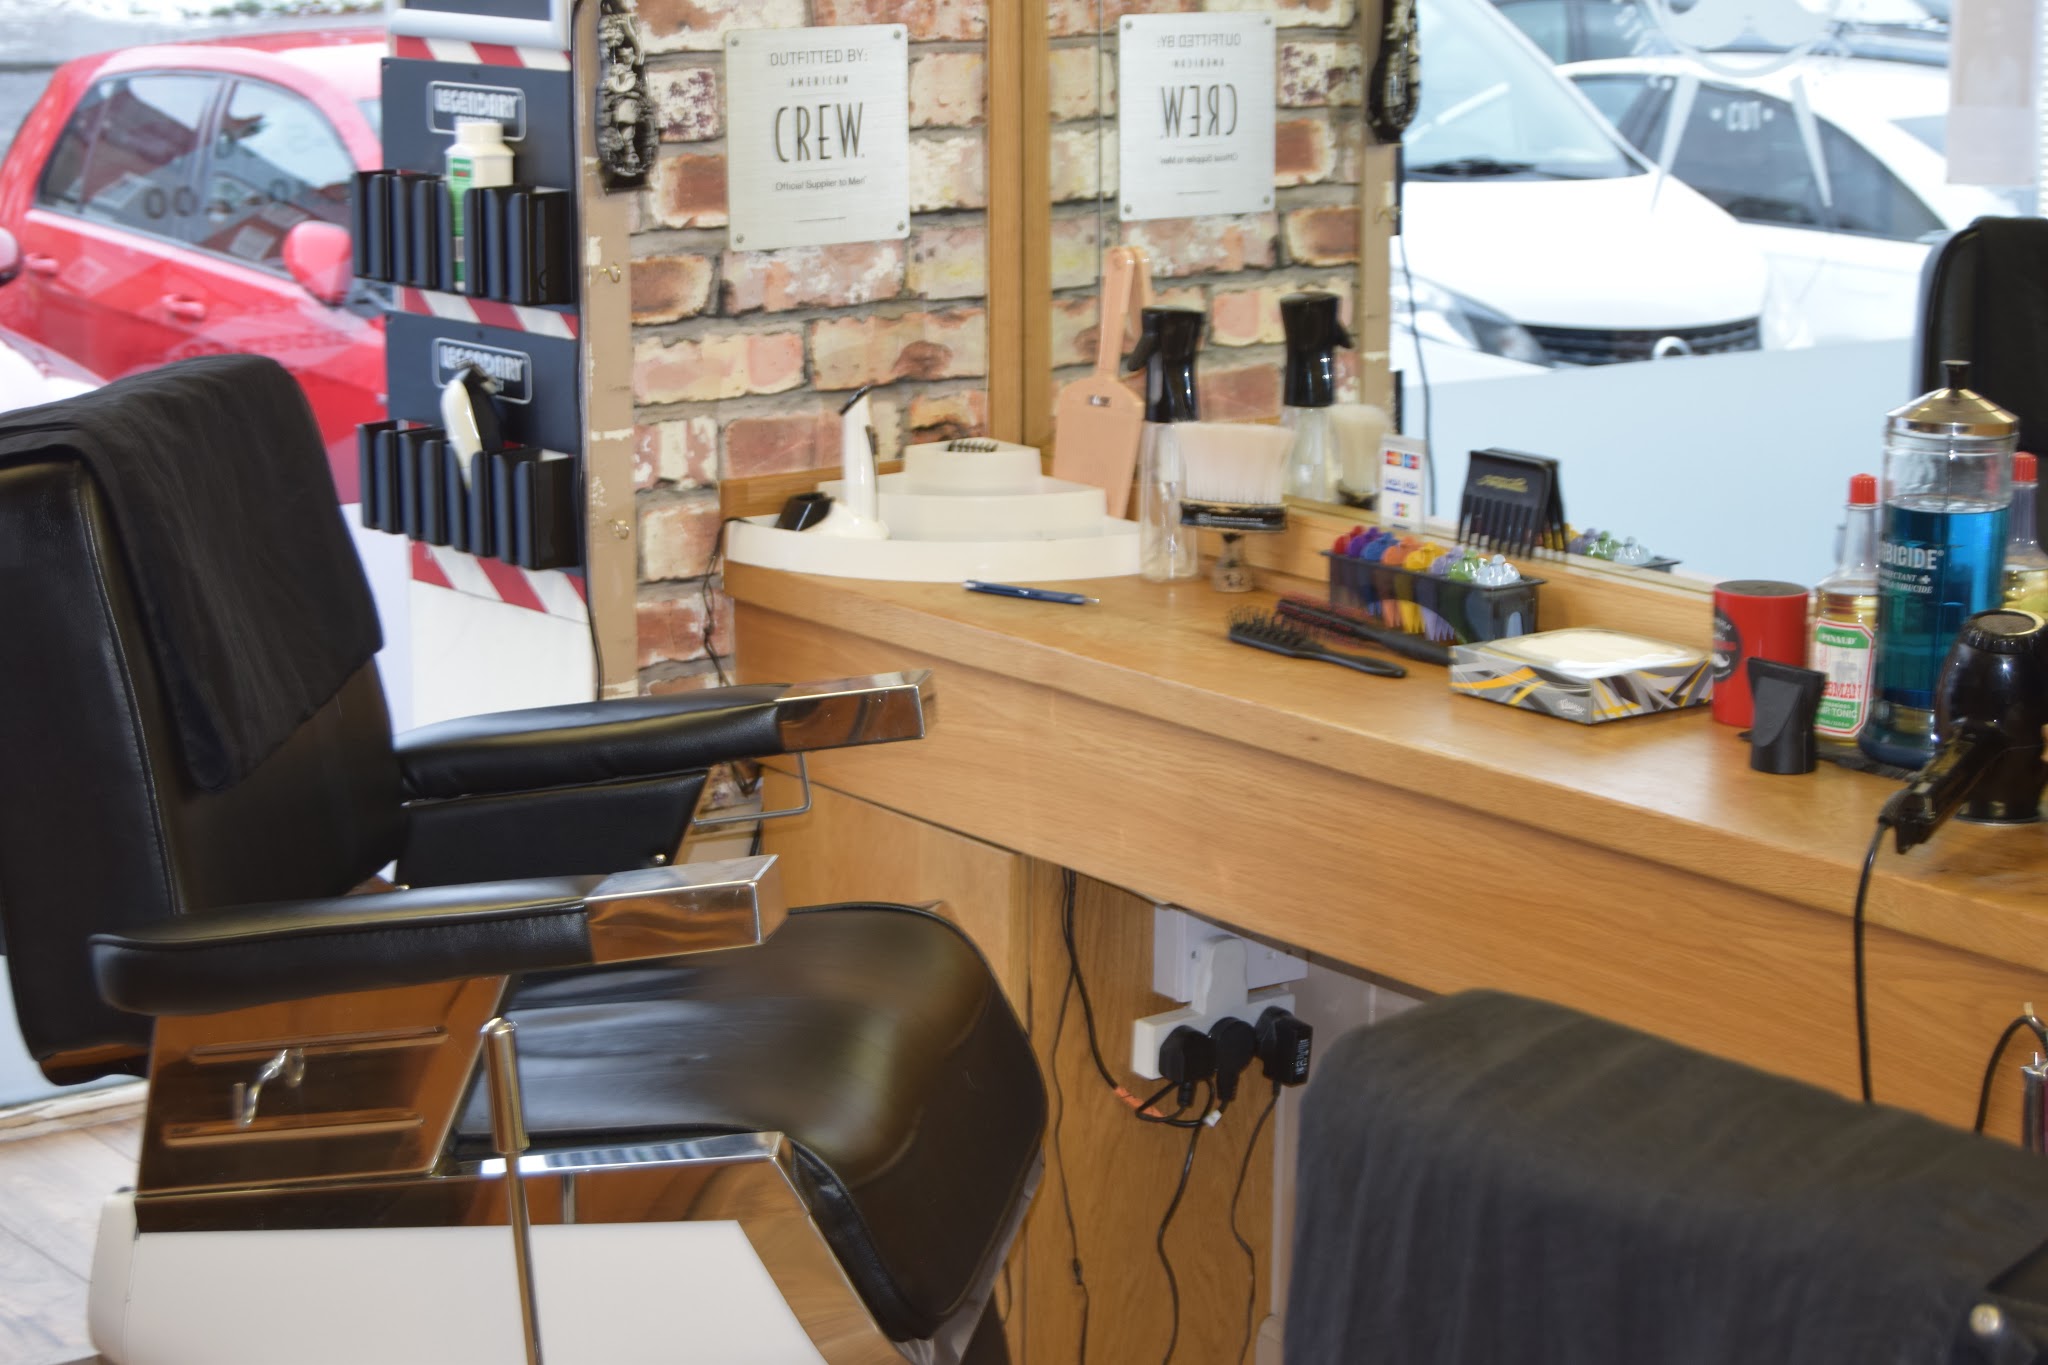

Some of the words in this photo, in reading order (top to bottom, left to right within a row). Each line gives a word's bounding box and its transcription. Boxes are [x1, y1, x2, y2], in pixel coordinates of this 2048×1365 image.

[770, 50, 843, 66] OUTFITTED
[790, 74, 849, 88] AMERICAN
[775, 178, 804, 191] Official
[806, 178, 837, 190] Supplier
[839, 178, 847, 186] to
[1822, 681, 1862, 699] BMAN
[1832, 707, 1858, 719] TONIC
